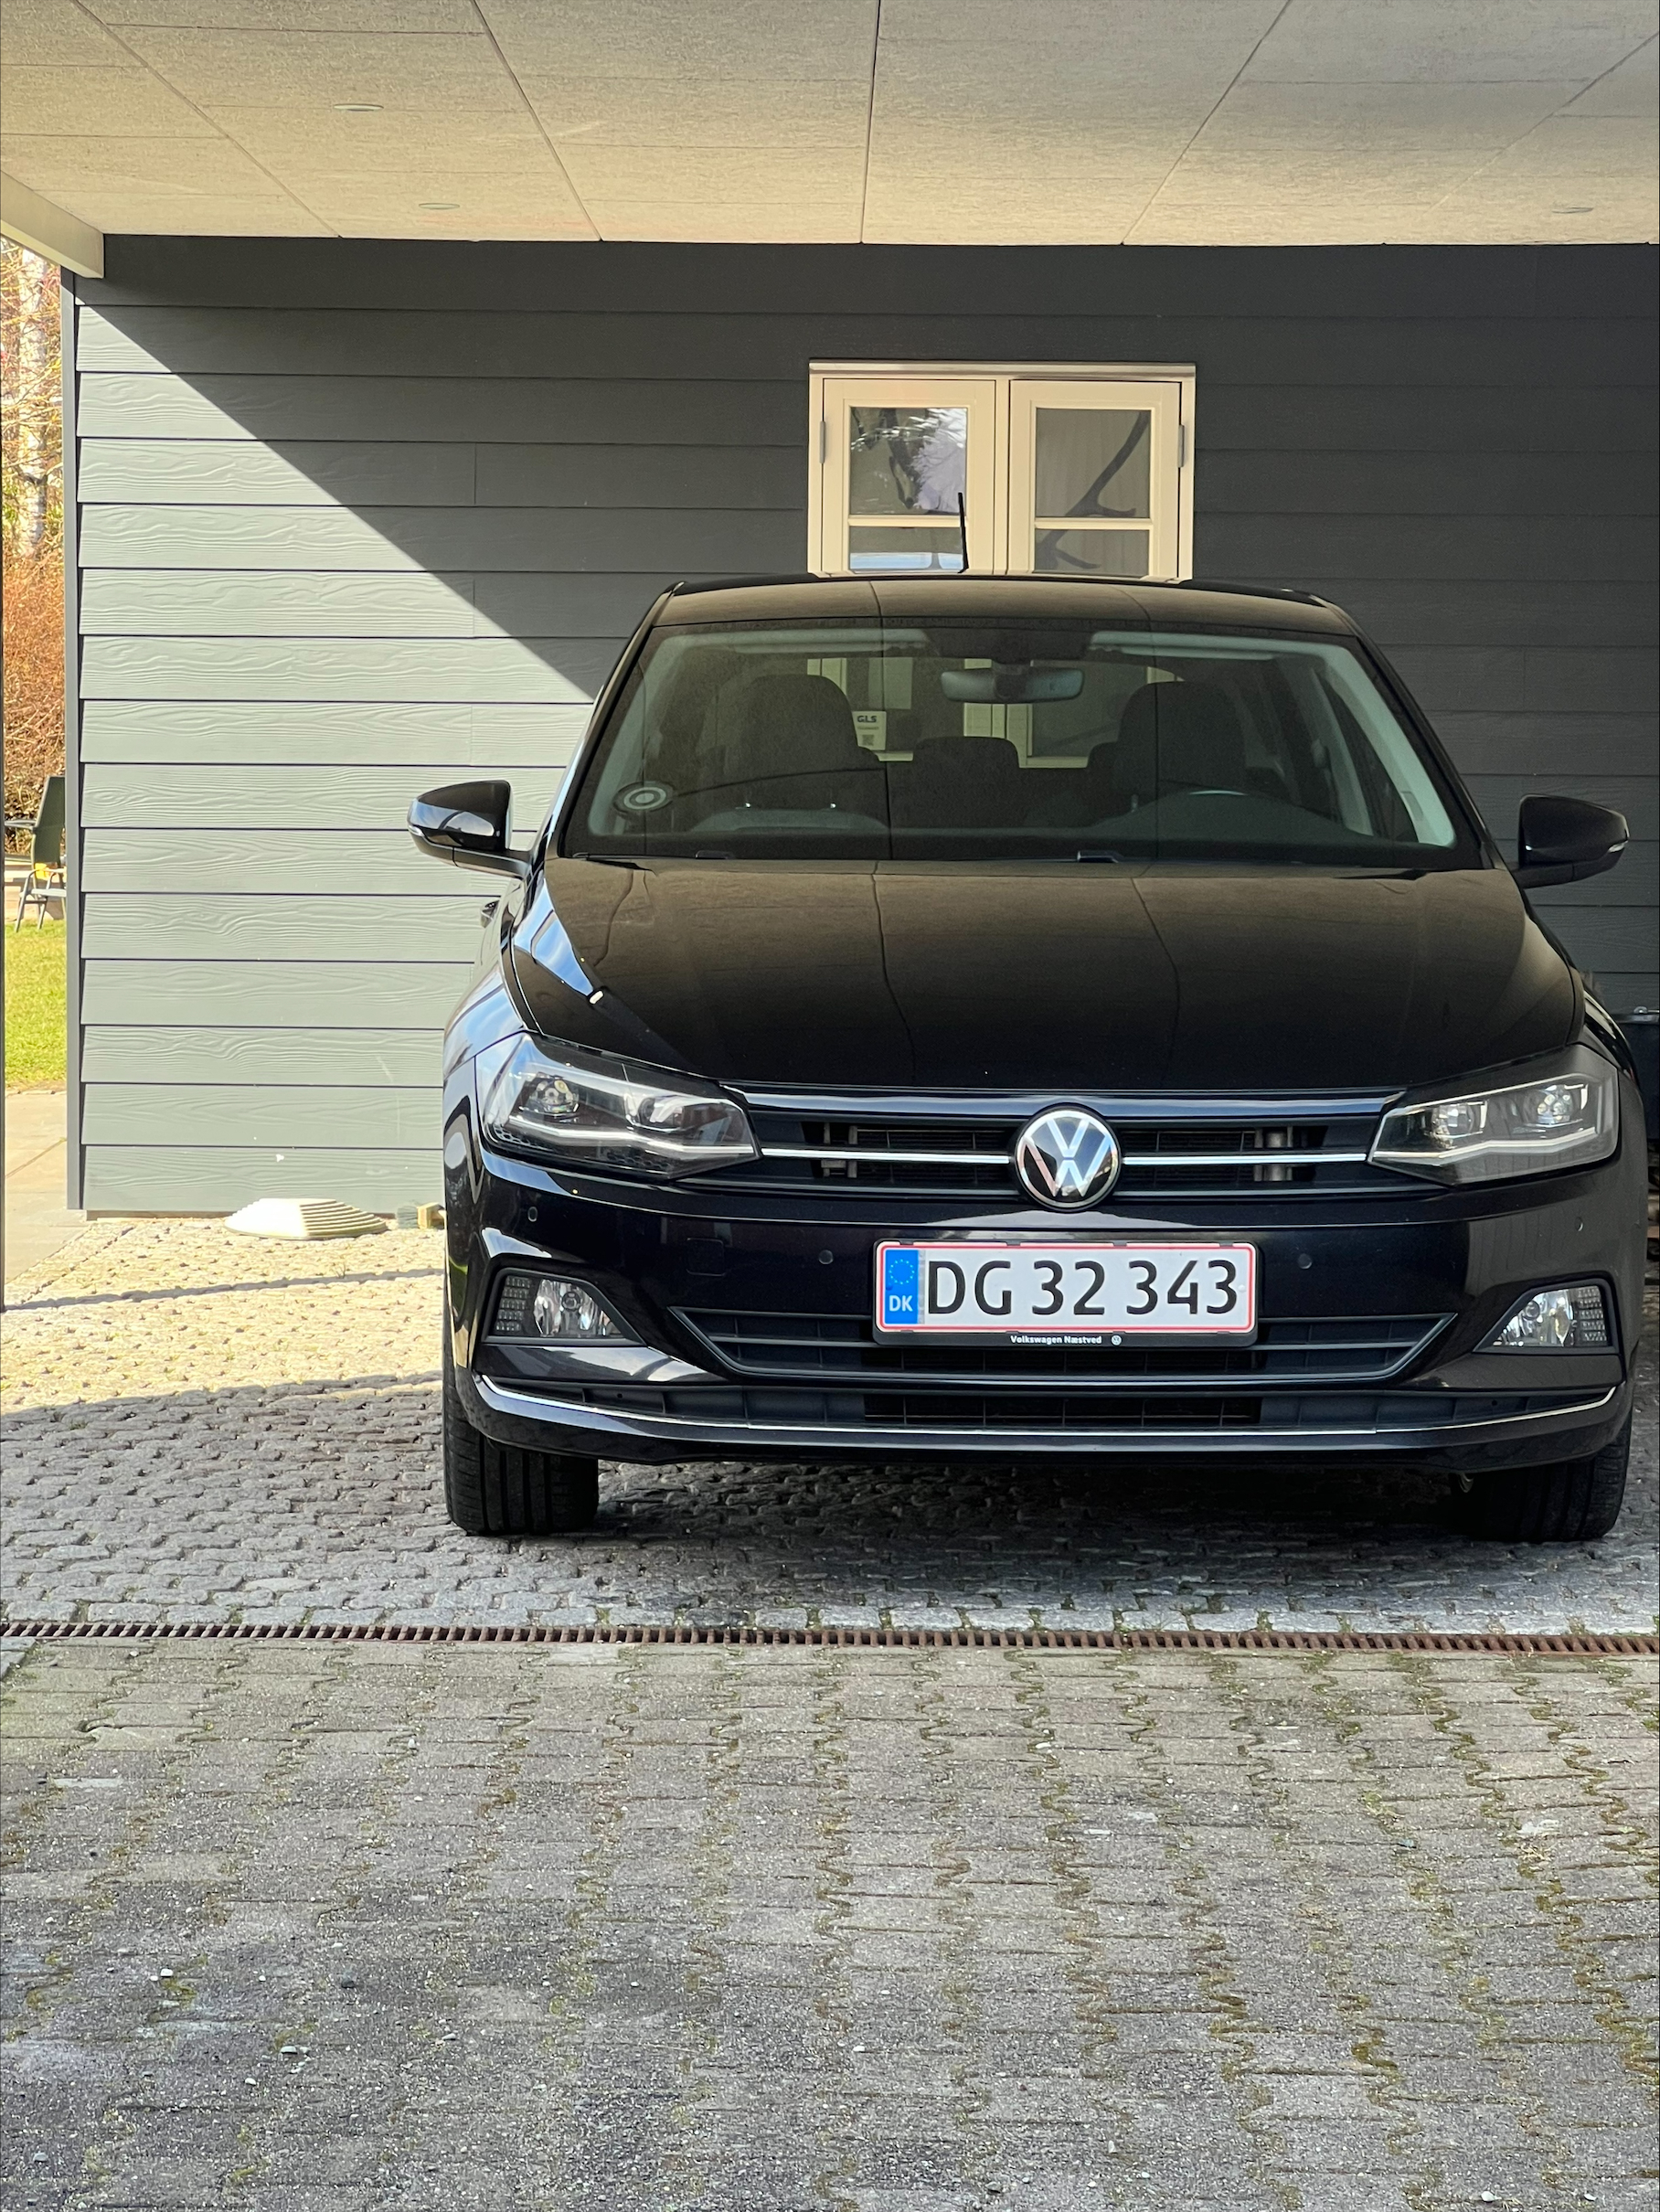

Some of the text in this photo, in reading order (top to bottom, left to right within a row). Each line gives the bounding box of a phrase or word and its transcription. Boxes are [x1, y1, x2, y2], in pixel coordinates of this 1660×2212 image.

[857, 715, 878, 723] GLS
[928, 1260, 1238, 1316] DG 32 343
[889, 1294, 914, 1313] DK
[1010, 1335, 1102, 1345] Volkswagen Næstved
